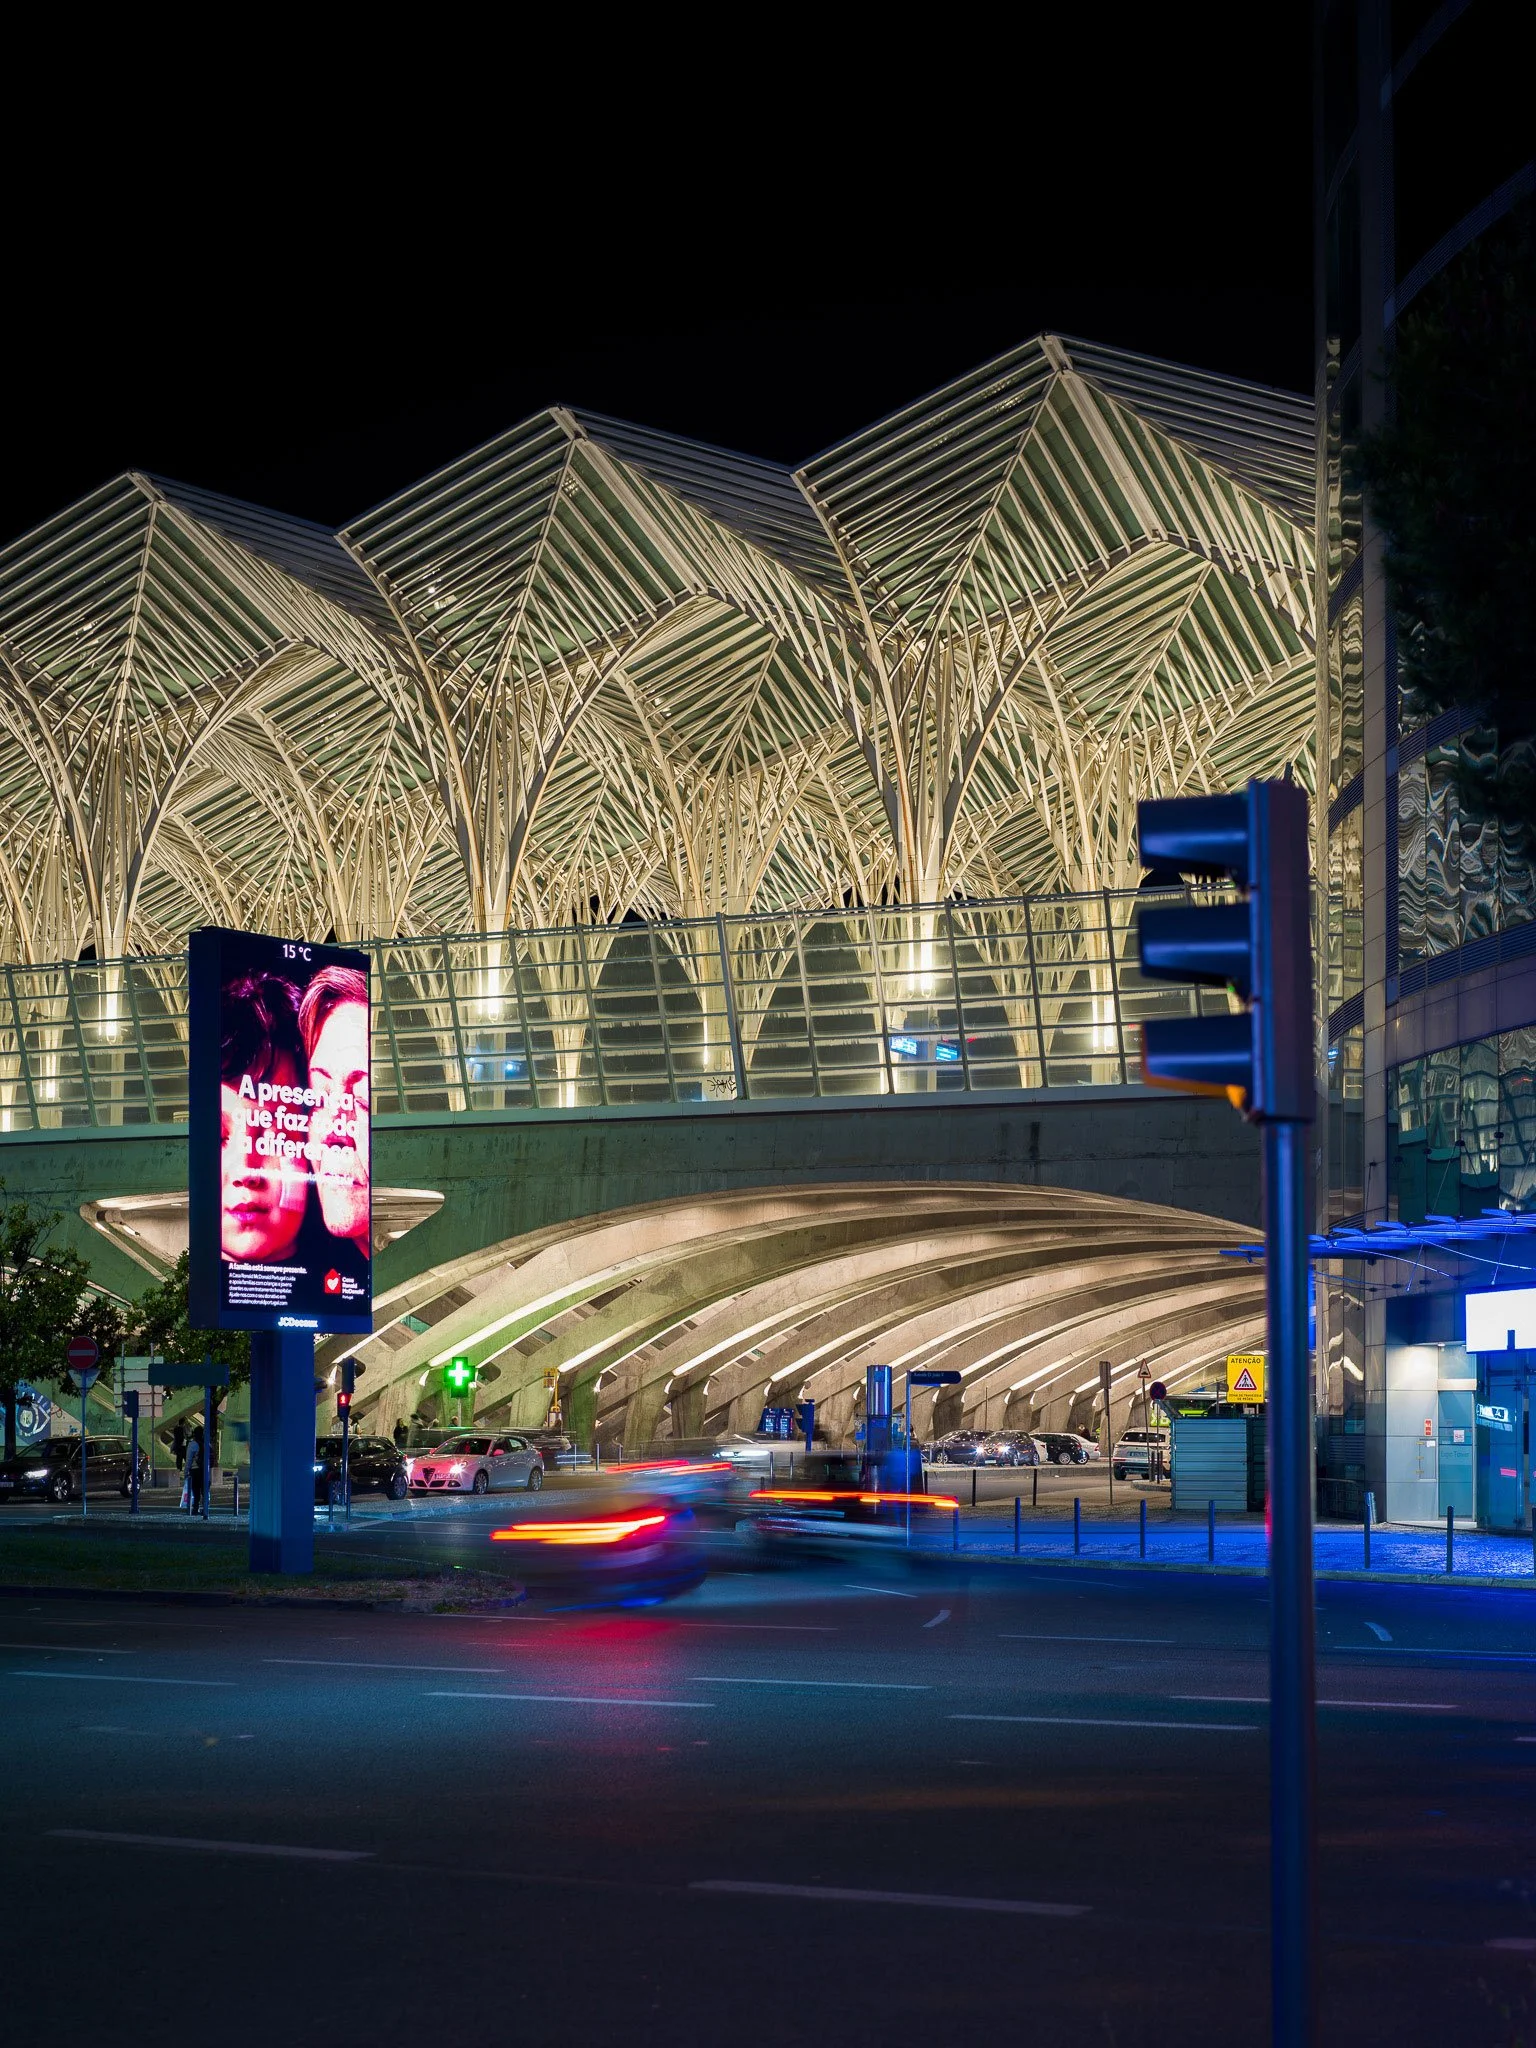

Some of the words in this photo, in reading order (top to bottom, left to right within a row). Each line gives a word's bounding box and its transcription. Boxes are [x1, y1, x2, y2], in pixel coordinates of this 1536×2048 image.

[283, 944, 296, 959] 15
[298, 946, 312, 961] °C
[239, 1074, 256, 1099] A
[258, 1082, 354, 1115] presença
[233, 1108, 273, 1132] que
[275, 1105, 309, 1132] faz
[311, 1112, 358, 1138] toda
[277, 1316, 318, 1328] JCDecaux
